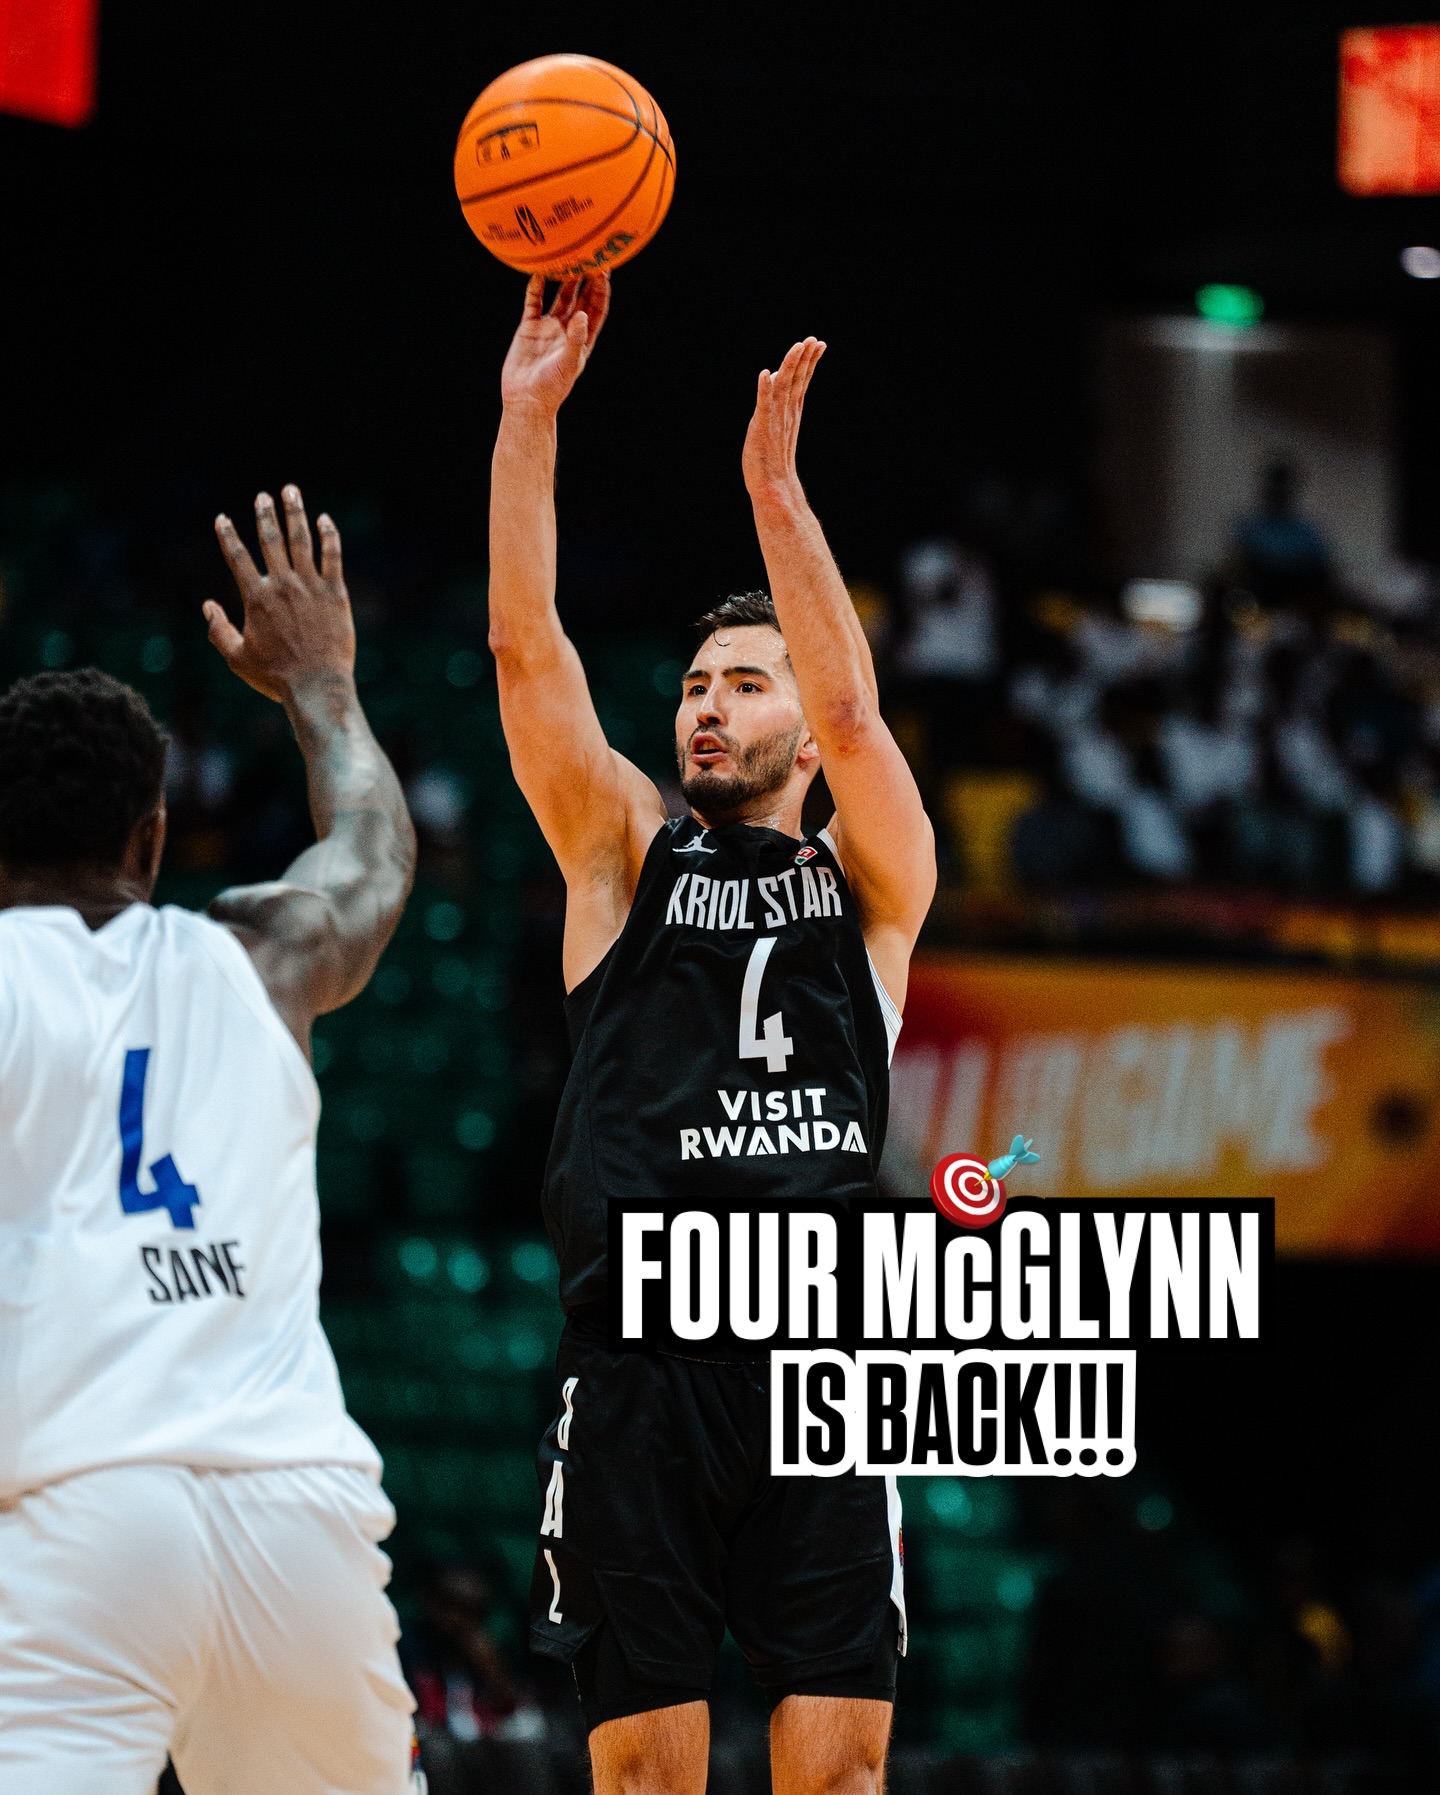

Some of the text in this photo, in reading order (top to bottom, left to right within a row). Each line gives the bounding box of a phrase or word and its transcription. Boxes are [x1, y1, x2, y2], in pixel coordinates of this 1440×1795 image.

[666, 866, 843, 931] KRIOL STAR
[739, 937, 794, 1072] 4
[717, 1088, 827, 1121] VISIT
[119, 1048, 200, 1230] 4
[680, 1120, 868, 1160] RWANDA
[141, 1241, 247, 1303] SANE
